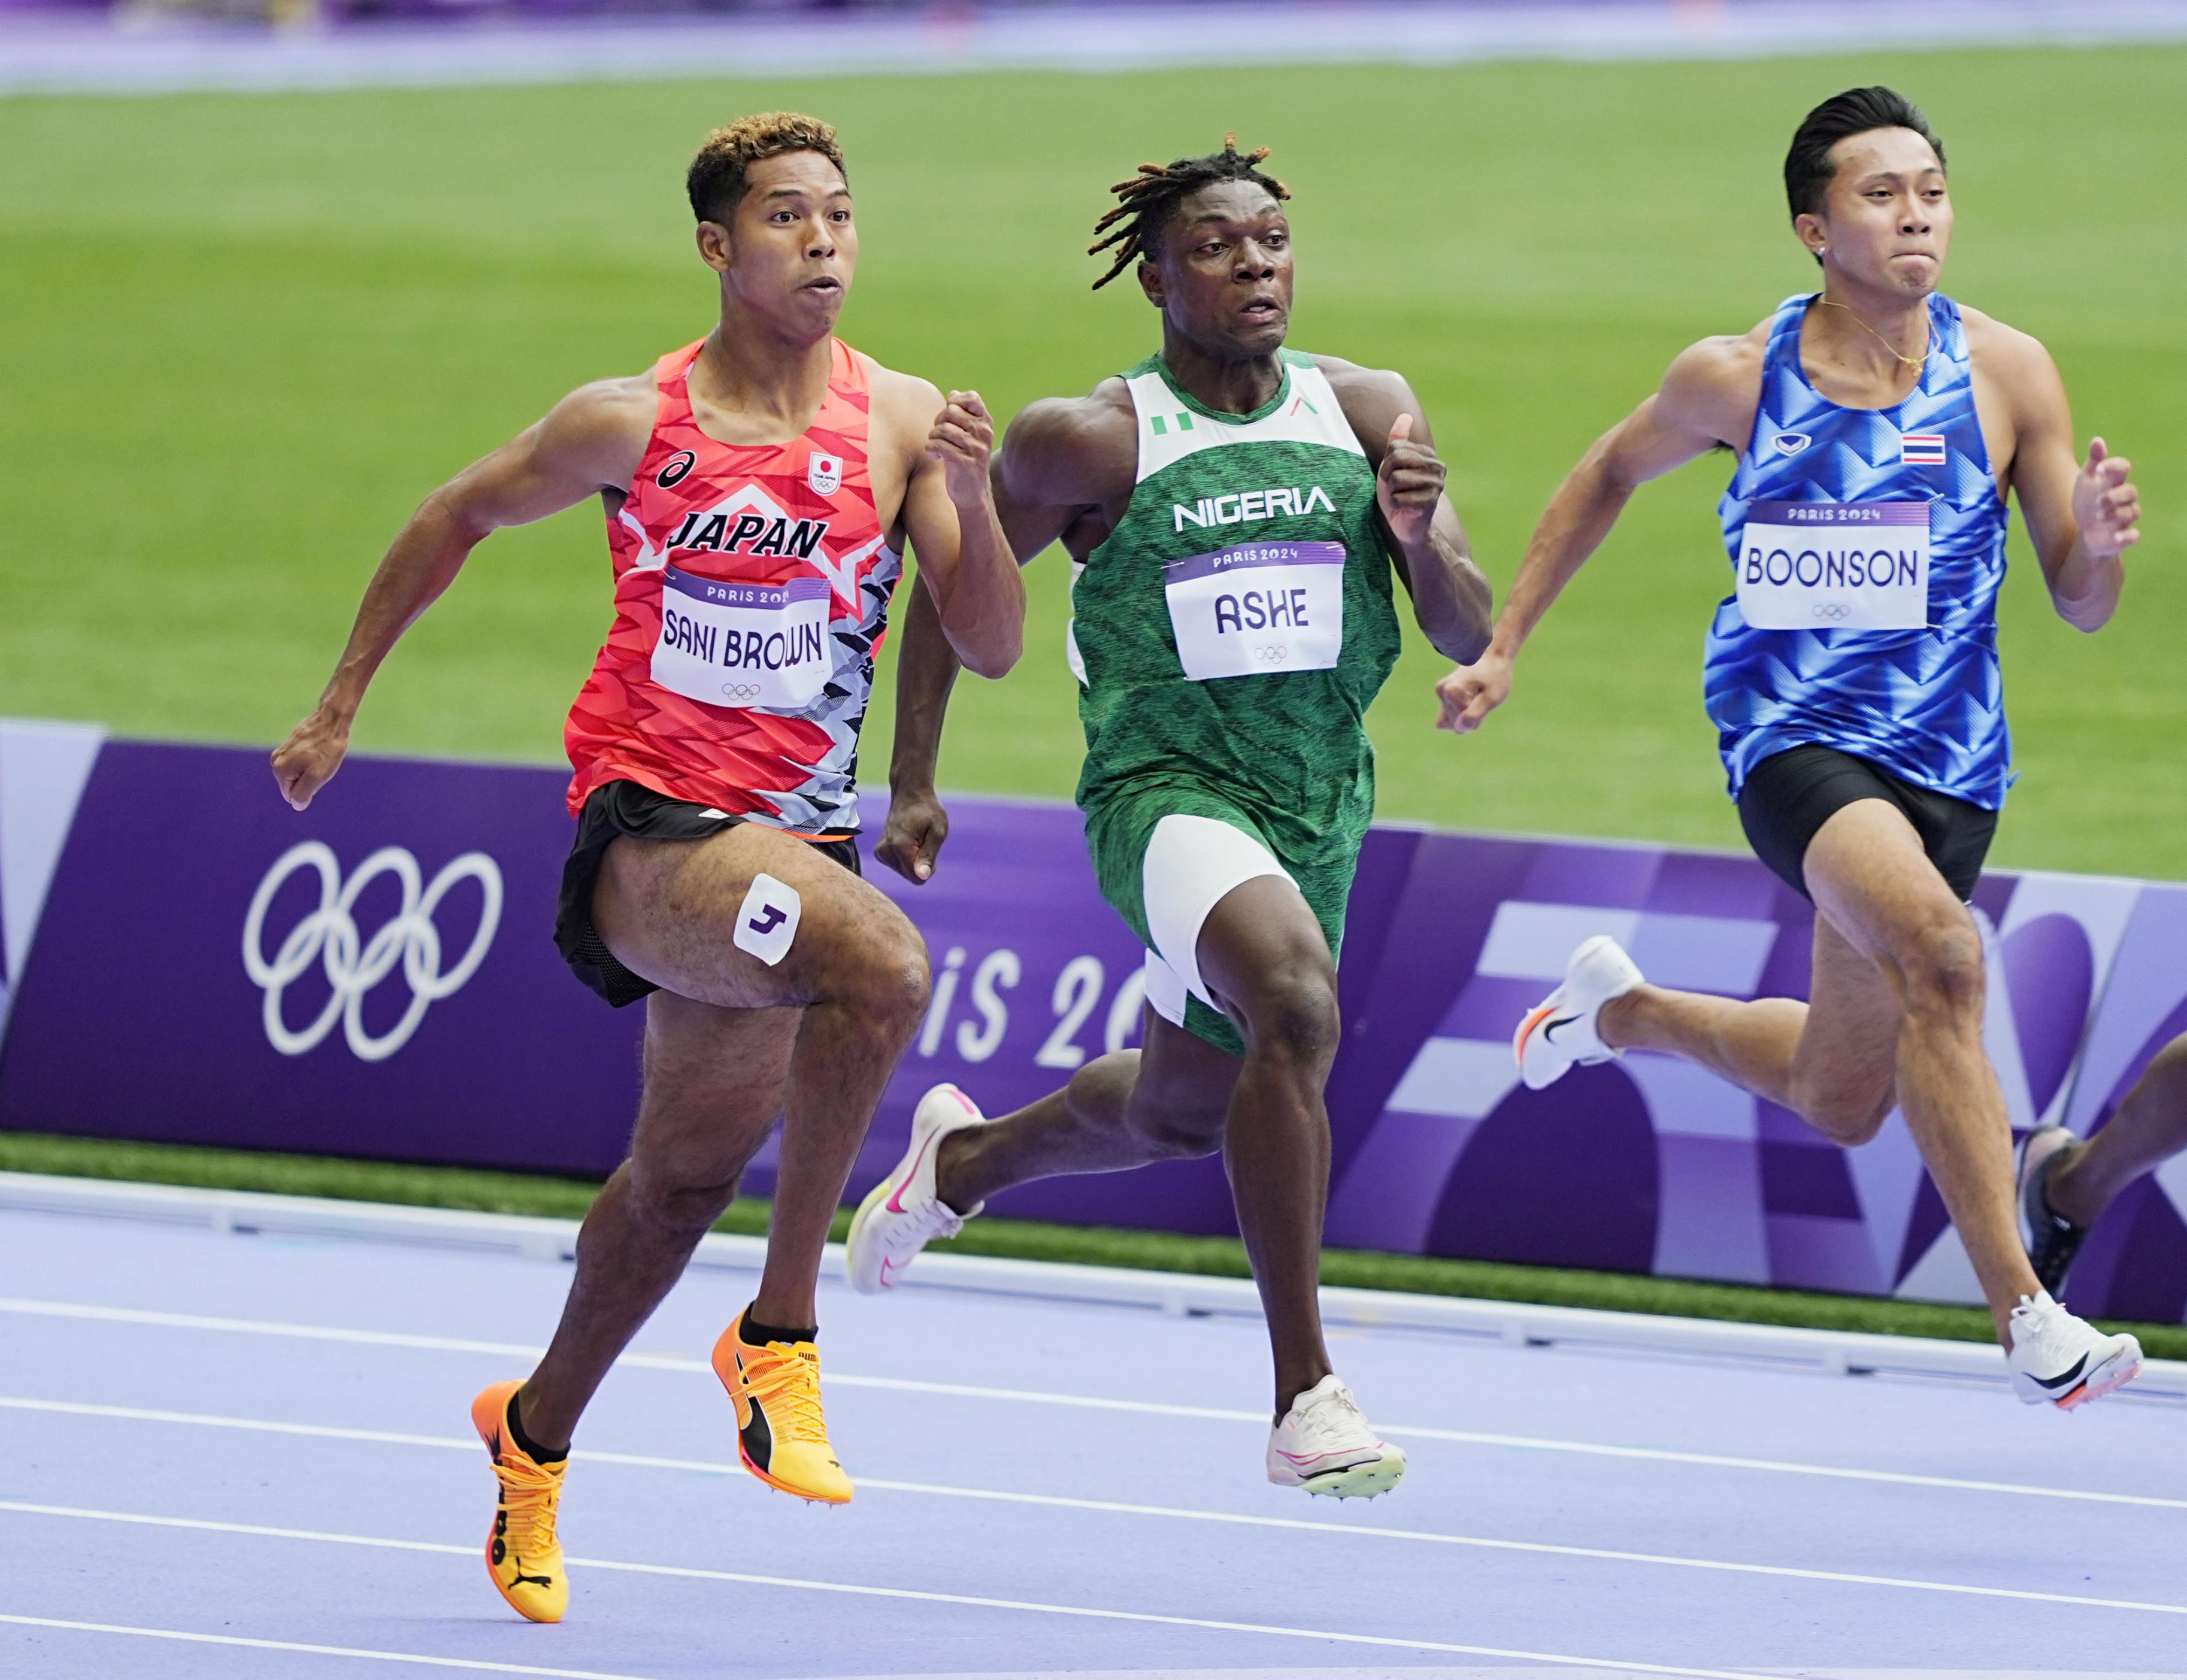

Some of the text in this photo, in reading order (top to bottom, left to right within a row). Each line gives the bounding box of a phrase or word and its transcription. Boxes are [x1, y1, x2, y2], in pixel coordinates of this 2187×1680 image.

[1173, 486, 1336, 532] NIGERIA
[1838, 509, 1880, 520] 2024
[665, 512, 829, 560] JAPAN
[1261, 548, 1297, 560] 2024
[1745, 547, 1918, 587] BOONSON
[1215, 588, 1309, 635] ASHE
[664, 609, 822, 670] SANI BROWN
